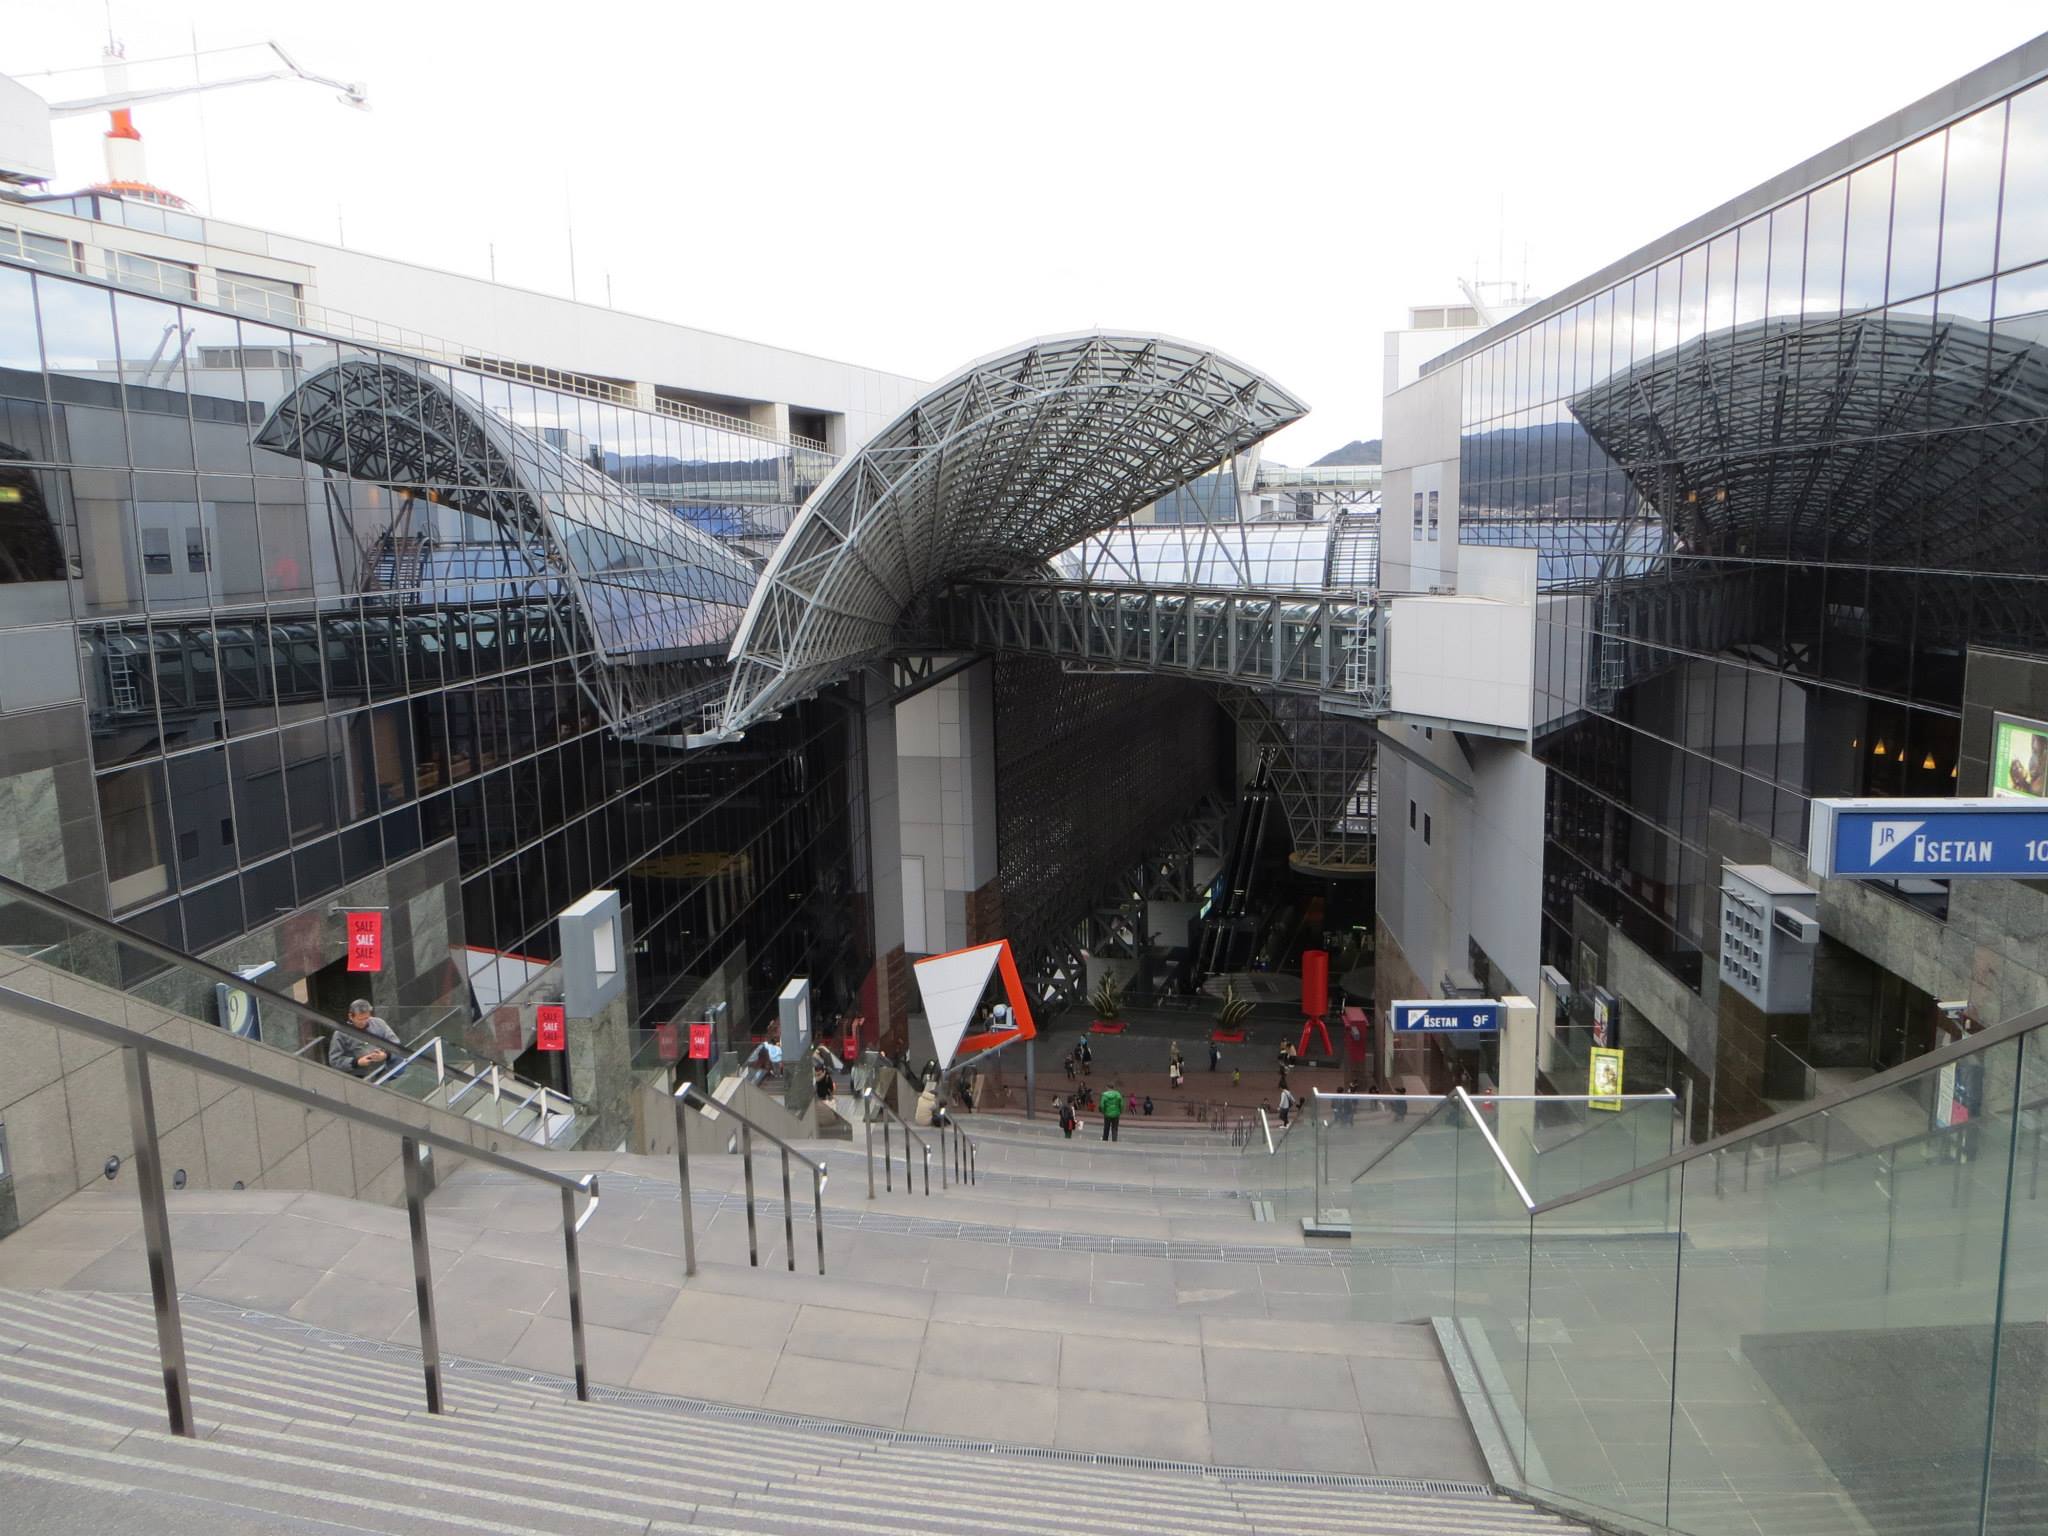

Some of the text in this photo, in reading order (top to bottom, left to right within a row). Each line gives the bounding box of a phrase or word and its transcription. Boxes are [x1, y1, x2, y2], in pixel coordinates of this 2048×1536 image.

[1880, 827, 1895, 846] JR
[354, 920, 374, 932] SALE
[355, 933, 375, 946] SALE
[354, 947, 374, 959] SALE
[1472, 1014, 1489, 1028] 9F
